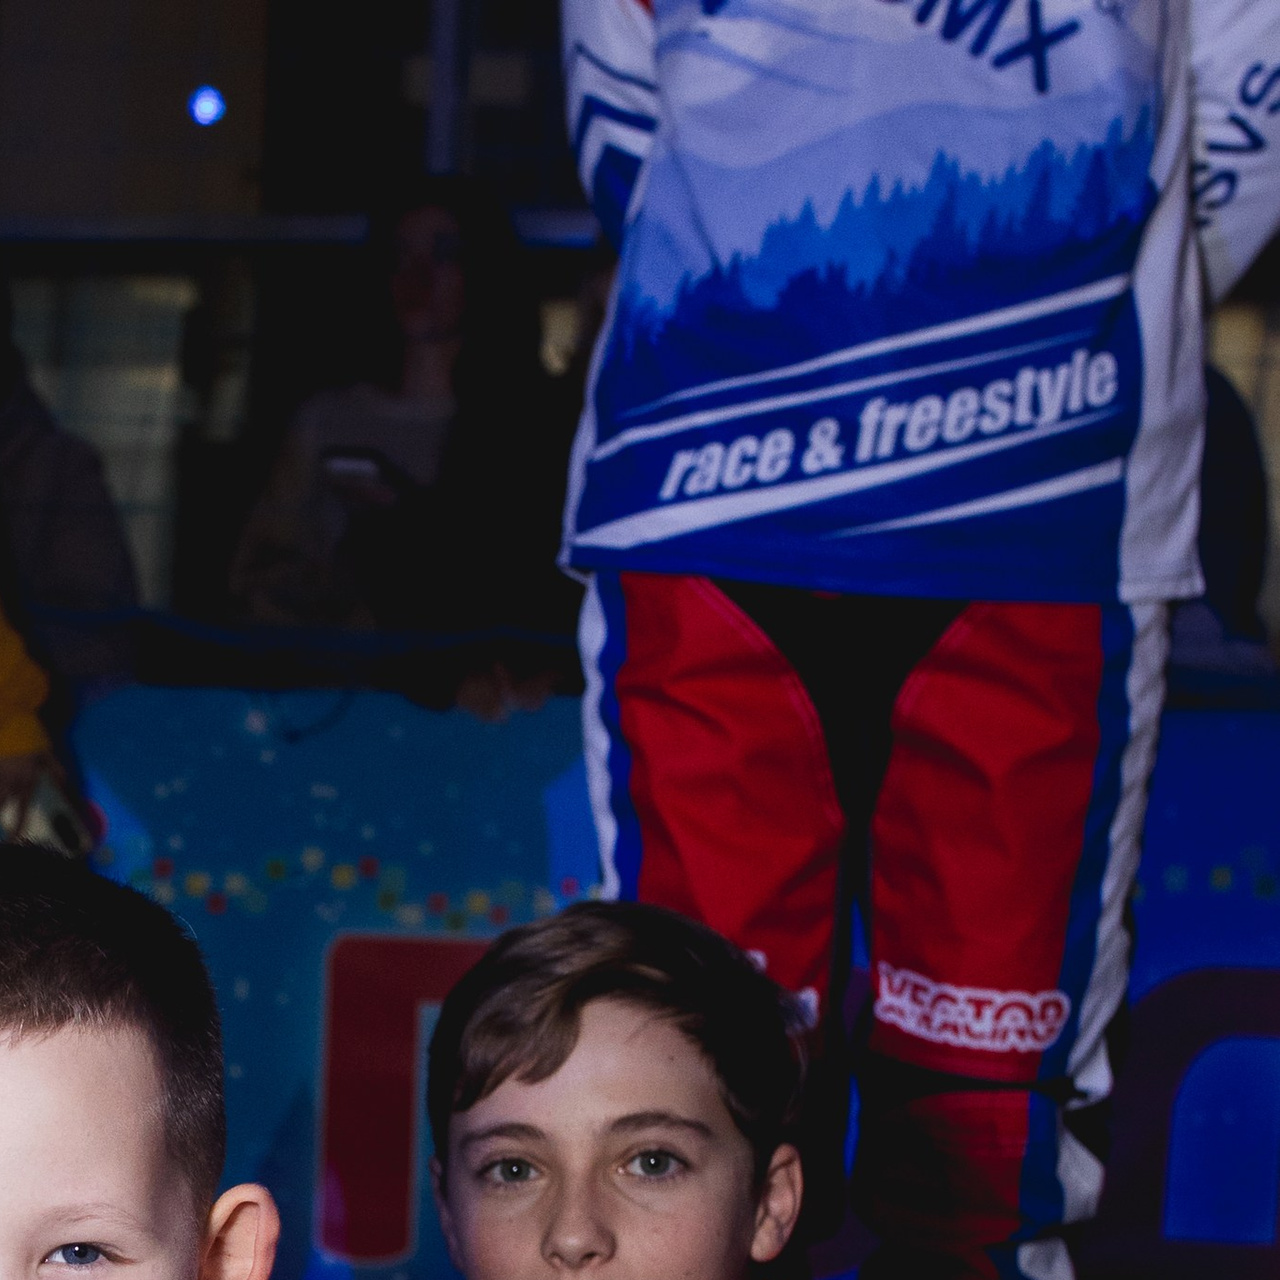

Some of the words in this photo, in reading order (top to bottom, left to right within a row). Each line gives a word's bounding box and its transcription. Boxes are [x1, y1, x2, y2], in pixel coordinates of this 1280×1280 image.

[658, 428, 795, 500] race
[801, 417, 845, 476] &
[854, 348, 1118, 466] freestyle
